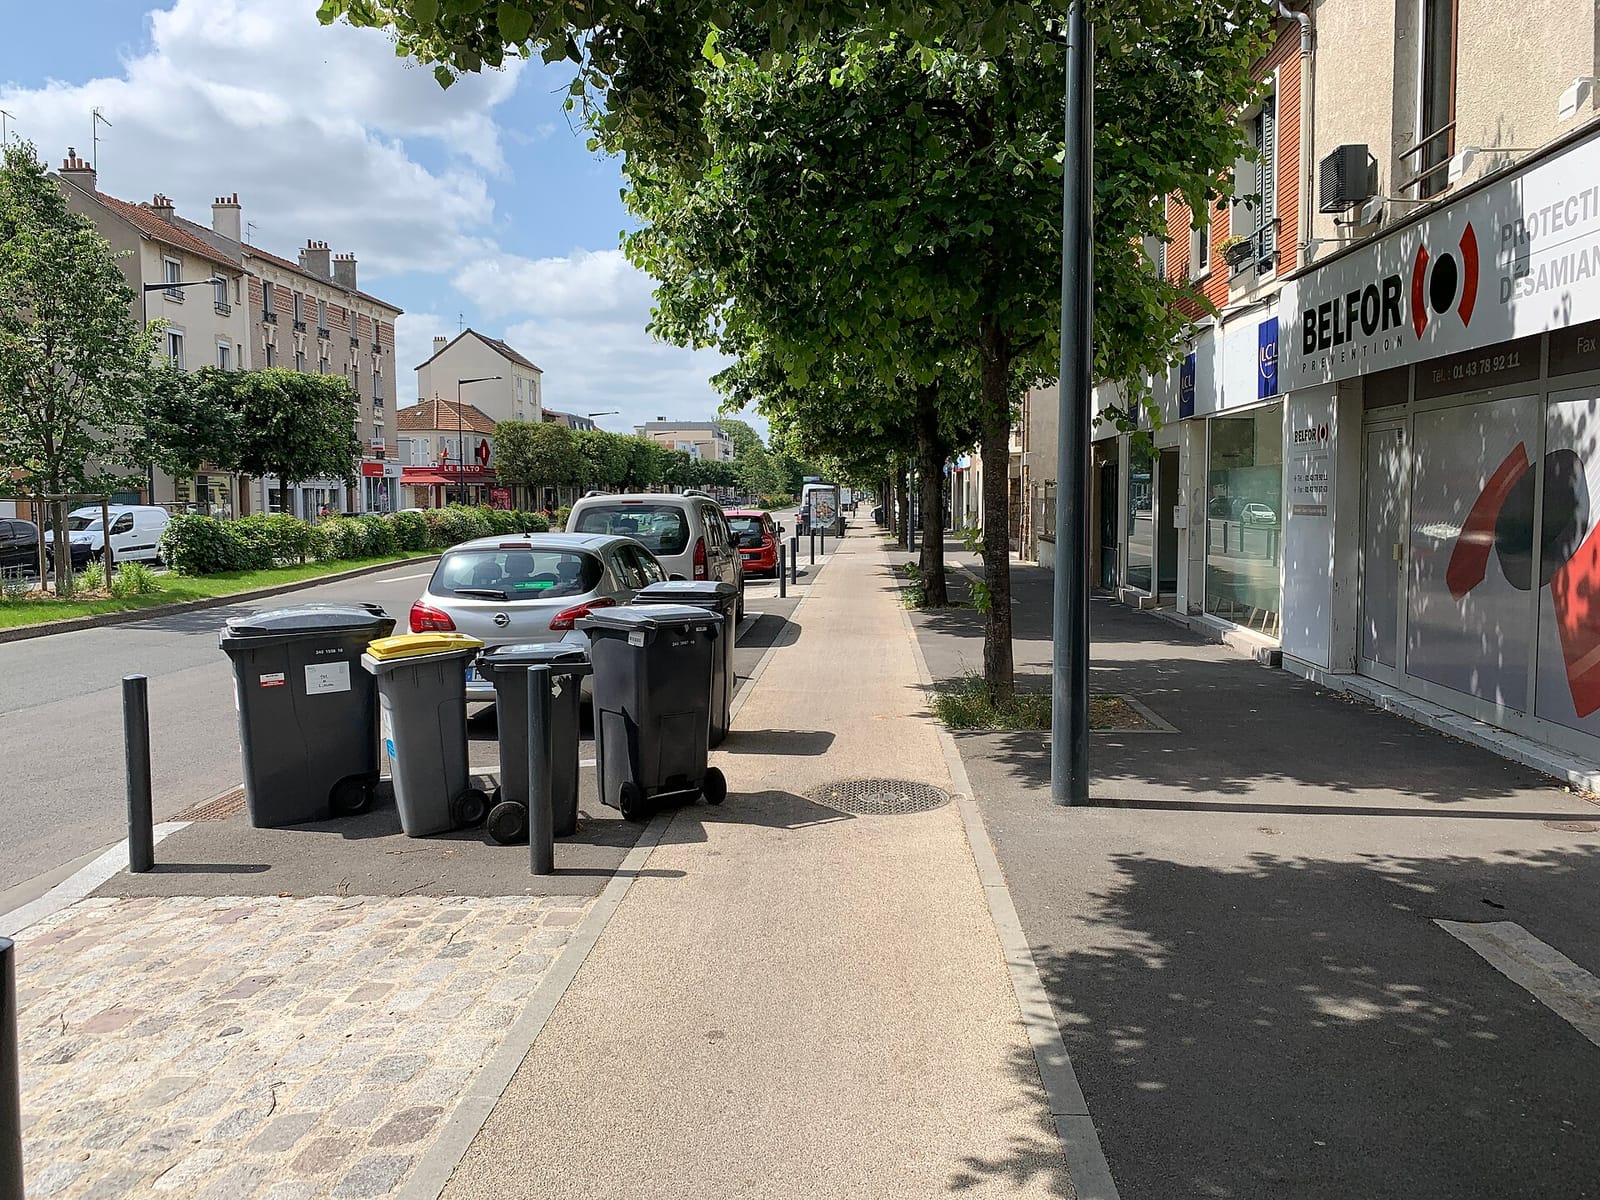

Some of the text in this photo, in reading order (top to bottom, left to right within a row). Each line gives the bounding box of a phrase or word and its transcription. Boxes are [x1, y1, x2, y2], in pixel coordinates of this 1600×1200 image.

[1501, 186, 1599, 252] PROTECTI
[1303, 274, 1402, 356] BELFOR
[1261, 343, 1278, 361] LCL
[1302, 335, 1402, 373] PREVENTION
[1576, 336, 1596, 354] Fax
[1453, 365, 1464, 379] 01
[1465, 361, 1478, 377] 43
[1479, 358, 1491, 374] 78
[1493, 355, 1505, 370] 92
[1507, 352, 1520, 368] 11
[1182, 375, 1193, 389] LCL
[1294, 428, 1317, 443] BELFOR
